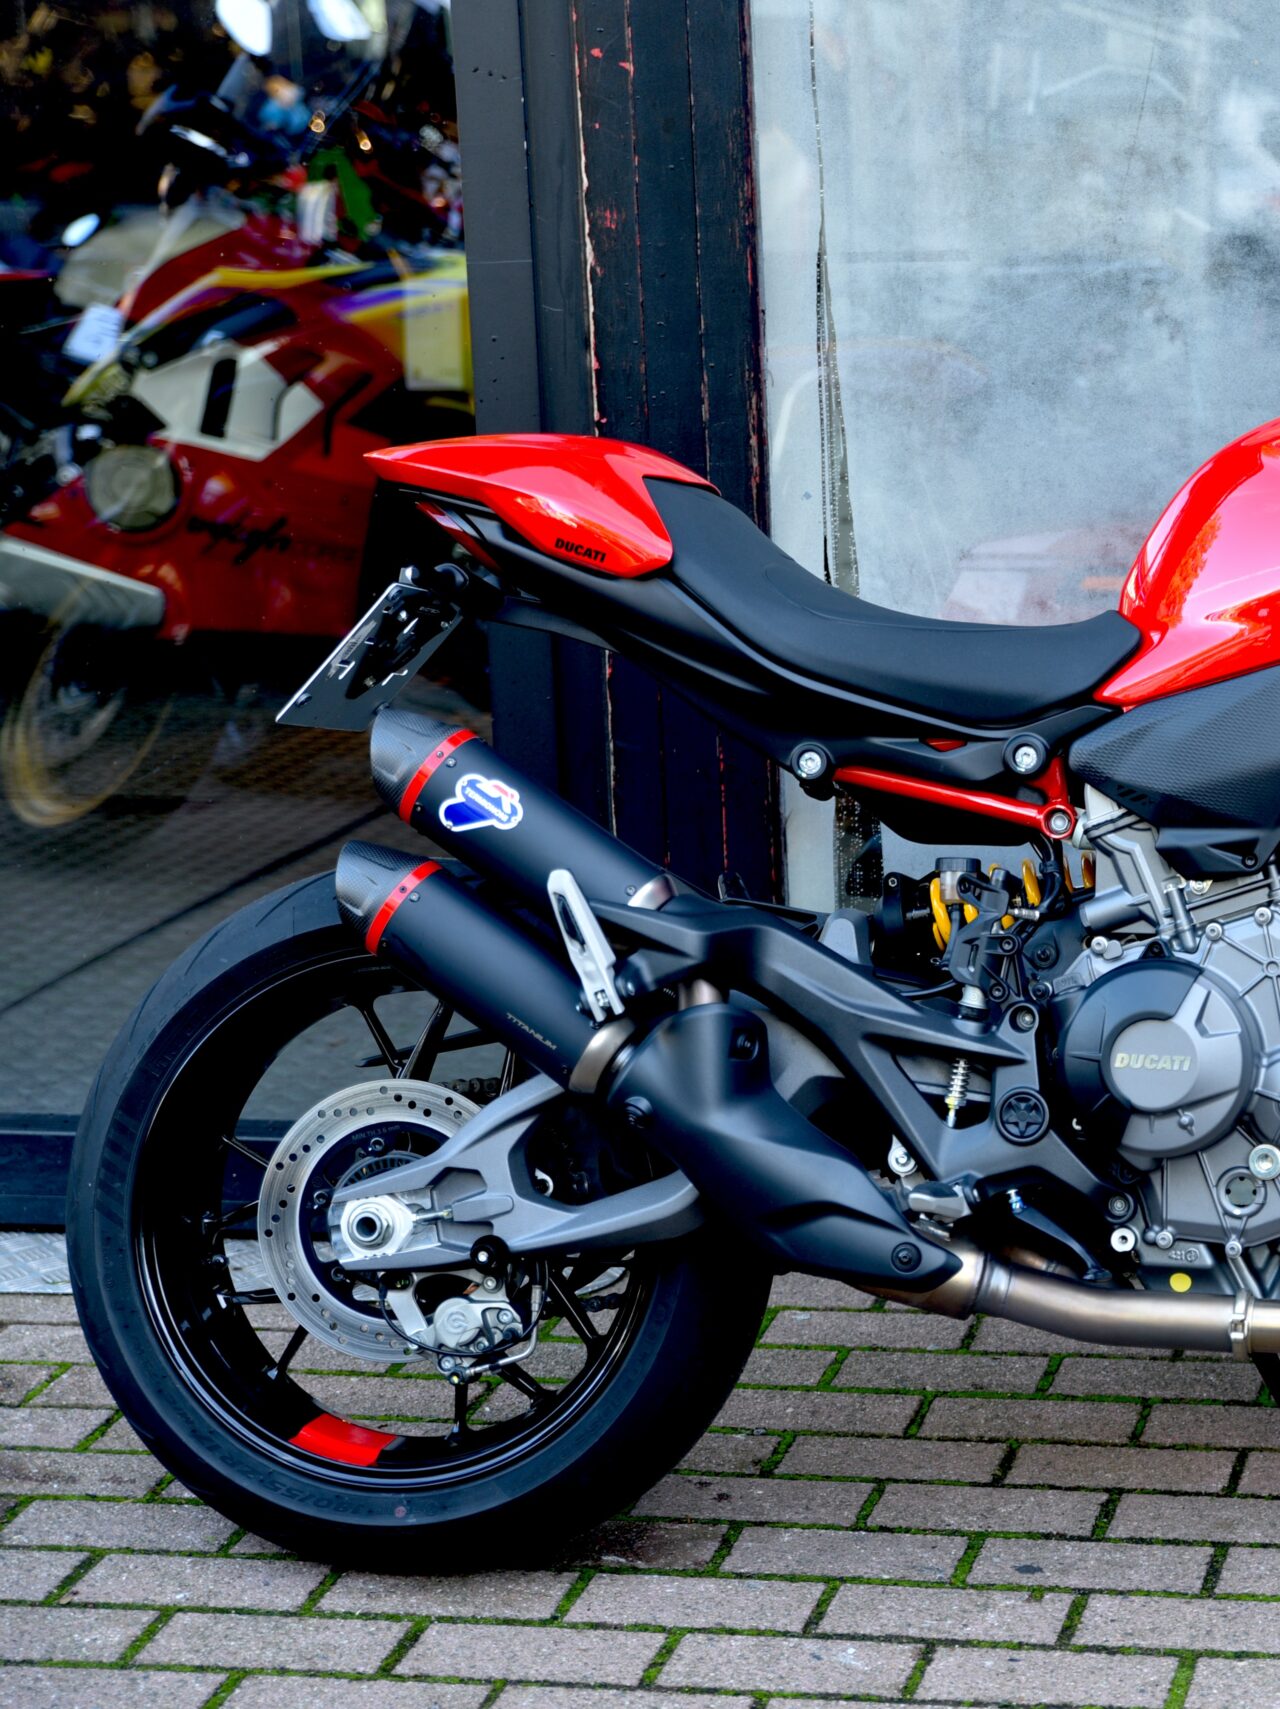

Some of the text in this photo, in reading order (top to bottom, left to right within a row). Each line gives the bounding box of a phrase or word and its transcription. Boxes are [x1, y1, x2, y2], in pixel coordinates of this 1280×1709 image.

[555, 538, 606, 563] DUCATI
[507, 1012, 557, 1050] TITANIUM
[1115, 1053, 1191, 1071] DUCATI
